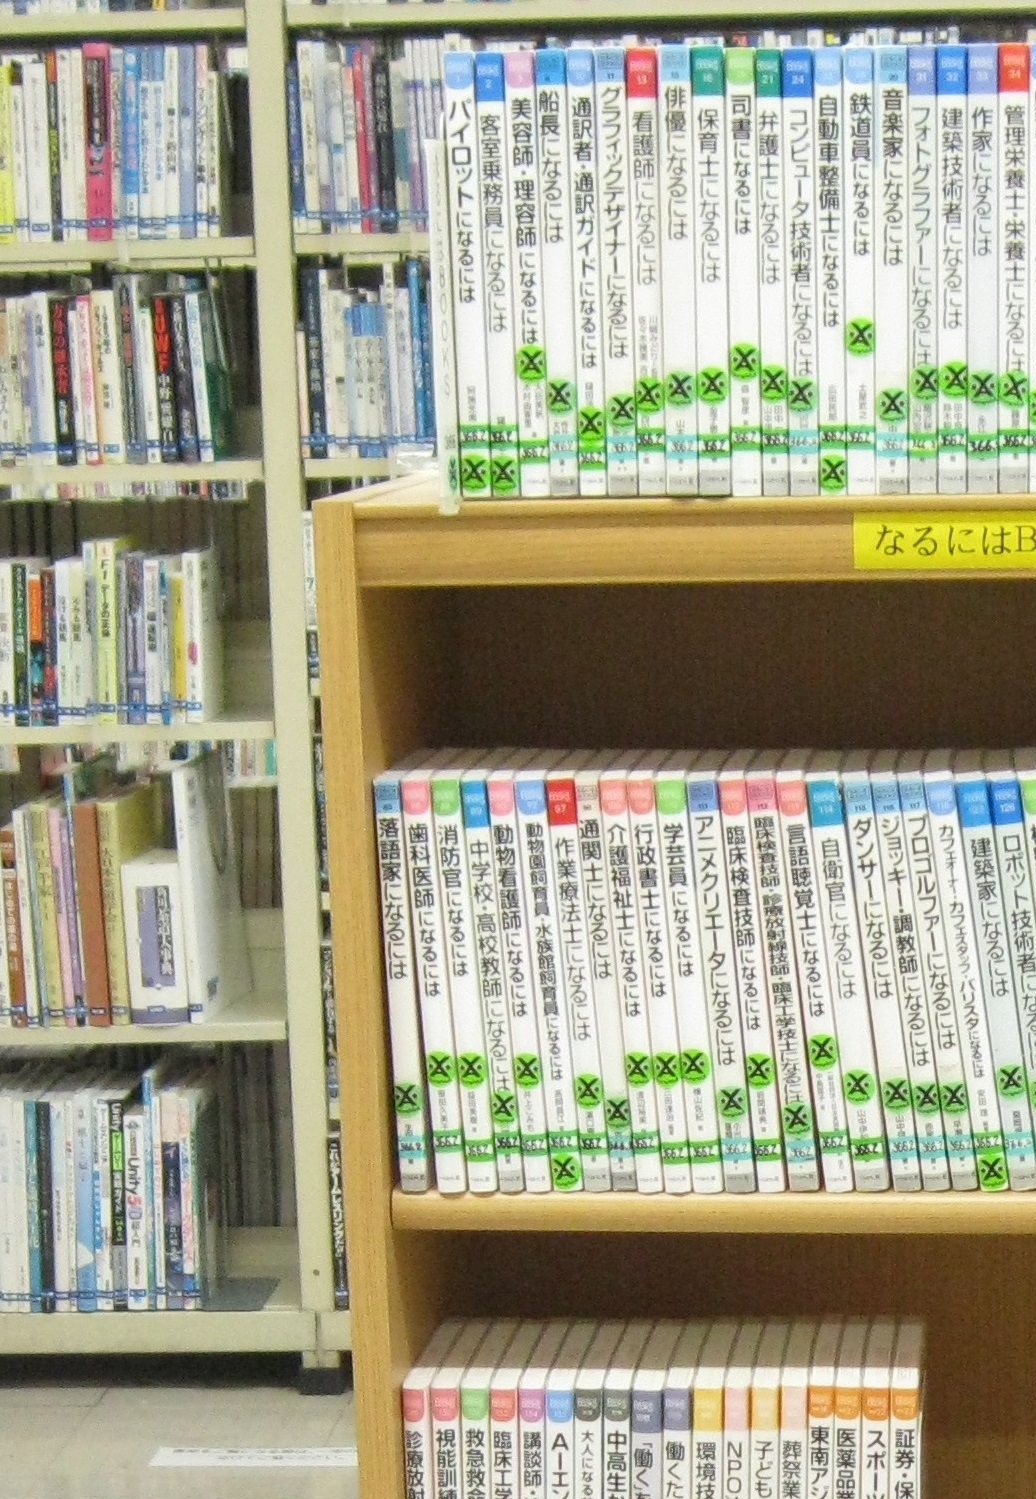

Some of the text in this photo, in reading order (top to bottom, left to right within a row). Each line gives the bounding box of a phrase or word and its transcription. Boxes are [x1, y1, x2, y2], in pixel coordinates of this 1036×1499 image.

[449, 99, 476, 303] パイロットになるには
[480, 116, 509, 332] 客室乗務員になるには
[512, 98, 537, 345] 美容師・理容師になるには
[539, 90, 564, 243] 船長になるには
[572, 97, 597, 368] 通訳者・通訳ガイドになるには
[601, 86, 629, 359] グラフィックデザイナーになるには
[632, 111, 655, 285] 看護師になるには
[664, 85, 687, 239] 俳優になるには
[698, 109, 720, 283] 保育士になるには
[731, 95, 750, 234] 司書になるには
[759, 111, 781, 284] 弁護士になるには
[818, 95, 839, 327] 自動車整備士になるには
[850, 93, 871, 255] 鉄道員になるには
[883, 88, 902, 265] 音楽家になるには
[942, 109, 963, 328] 建築技術者になるには
[972, 107, 993, 255] 作家になるには
[378, 818, 408, 980] 落語家になるには
[409, 823, 440, 997] 歯科医師になるには
[437, 824, 468, 976] 消防官になるには
[493, 825, 526, 1017] 動物看護師になるには
[555, 838, 590, 1041] 作業療法士になるには
[578, 820, 612, 980] 通関士になるには
[608, 824, 640, 1017] 介護福祉士になるには
[634, 824, 666, 998] 行政書士になるには
[663, 823, 694, 977] 学芸員になるには
[696, 817, 736, 1066] アニメクリエータになるには
[726, 826, 761, 1030] 臨床検査技師になるには
[785, 824, 825, 1016] 言語聴覚士になるには
[820, 839, 856, 999] 自衛官になるには
[853, 817, 893, 999] ダンサーになるには
[882, 817, 930, 1067] ジョッキー・調教師になるには
[908, 815, 956, 1049] プロゴルファーになるには
[970, 839, 1009, 997] 建築家になるには
